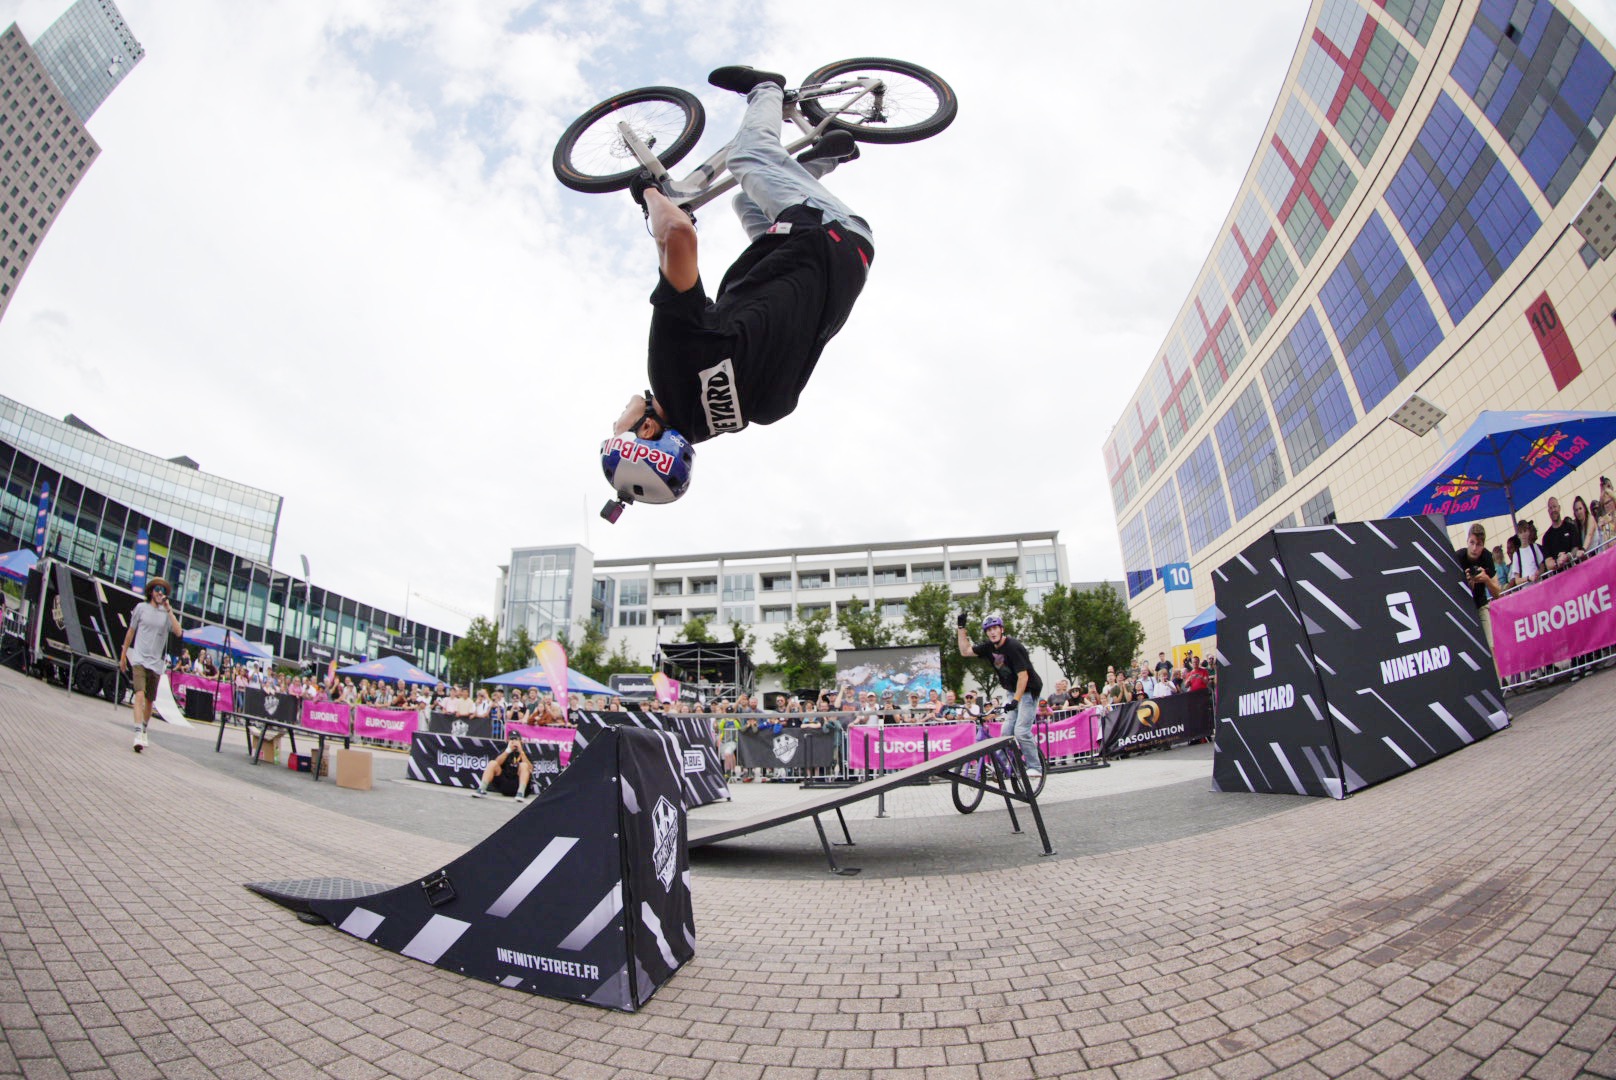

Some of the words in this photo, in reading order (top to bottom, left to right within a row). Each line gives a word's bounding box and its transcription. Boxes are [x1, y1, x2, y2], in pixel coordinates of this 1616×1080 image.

[1532, 301, 1557, 337] 10
[707, 371, 738, 434] EYARD
[604, 438, 636, 459] Bull
[633, 446, 675, 474] Red
[1170, 567, 1190, 586] 10
[1514, 584, 1612, 643] EUROBIKE
[1379, 645, 1451, 685] NINEYARD
[1238, 683, 1295, 717] NINEYARD
[310, 710, 339, 723] EUROBIKE
[365, 717, 405, 731] EUROBIKE
[1034, 727, 1076, 744] OBIKE
[1118, 723, 1185, 747] RASOULUTION
[437, 750, 489, 773] Inspired
[532, 758, 559, 779] spired
[497, 947, 599, 980] INFINITYSTREET.FR
